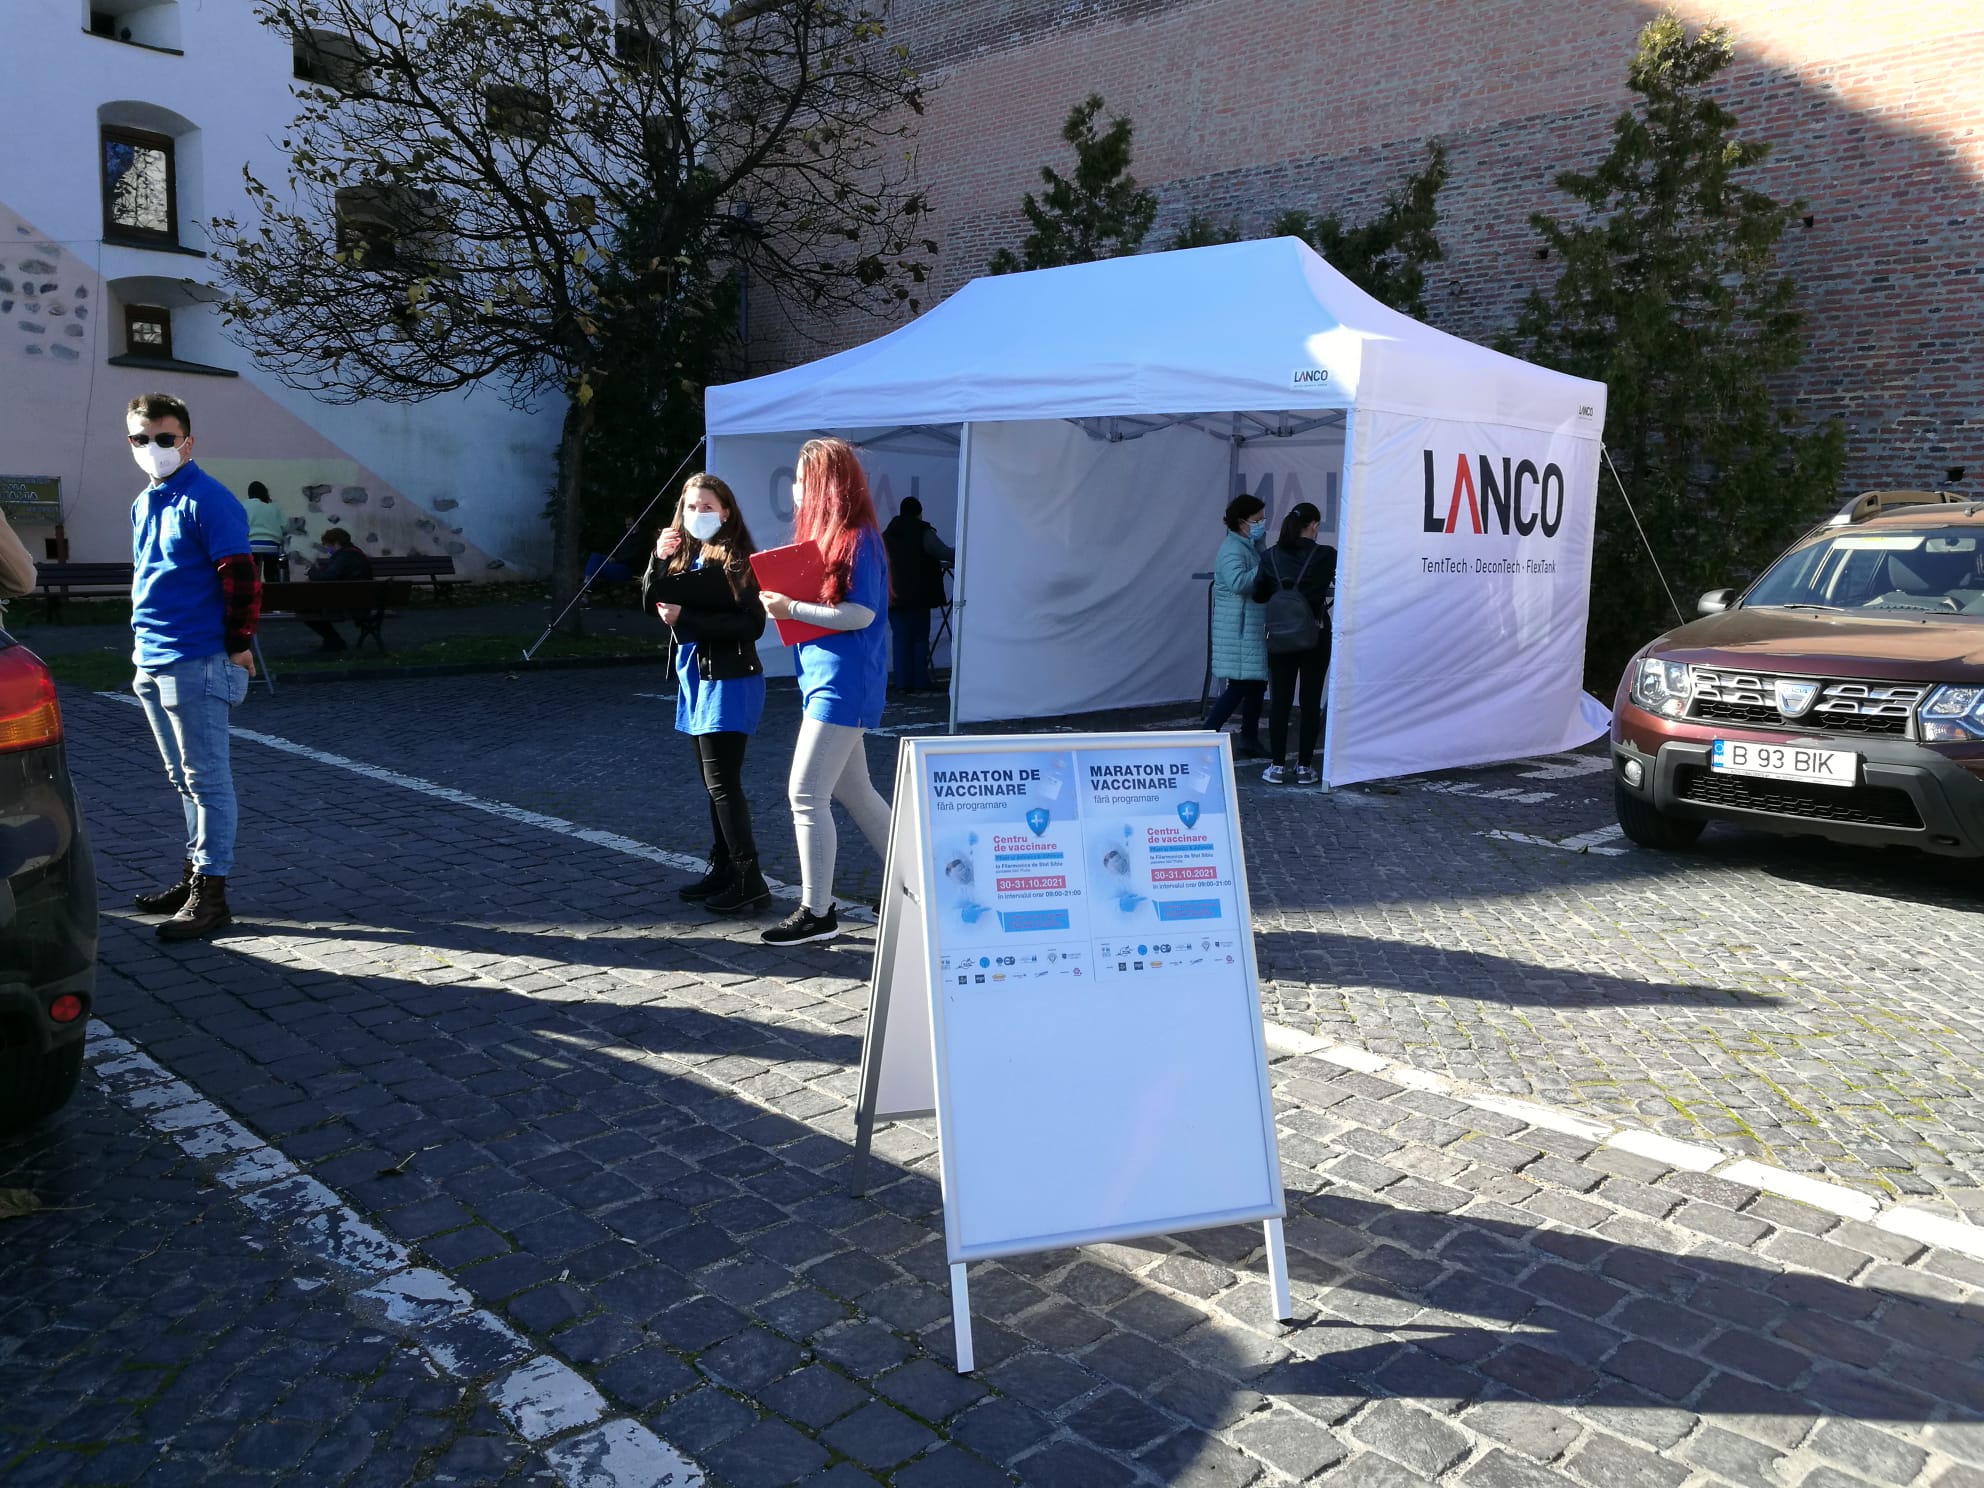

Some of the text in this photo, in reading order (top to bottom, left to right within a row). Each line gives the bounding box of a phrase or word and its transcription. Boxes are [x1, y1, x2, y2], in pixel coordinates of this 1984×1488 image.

[1294, 370, 1328, 382] LANCO
[1424, 450, 1564, 538] LANCO
[1422, 558, 1556, 574] TentTech DeconTech FlexTank
[1733, 746, 1747, 765] B
[1758, 749, 1784, 769] 93
[1795, 751, 1834, 774] BIK
[933, 769, 1041, 783] MARATON DE
[1090, 764, 1190, 777] MARATON DE
[1091, 778, 1177, 791] VACCINARE
[934, 784, 1026, 797] VACCINARE
[1112, 795, 1159, 805] programare
[957, 801, 1007, 812] programare
[1147, 827, 1179, 835] Centru
[993, 835, 1028, 844] Centru
[1161, 834, 1207, 843] vaccinare
[994, 842, 1057, 852] de vaccinare
[1154, 869, 1214, 880] 30-31.10.2021
[1000, 878, 1063, 889] 30-31.10.2021
